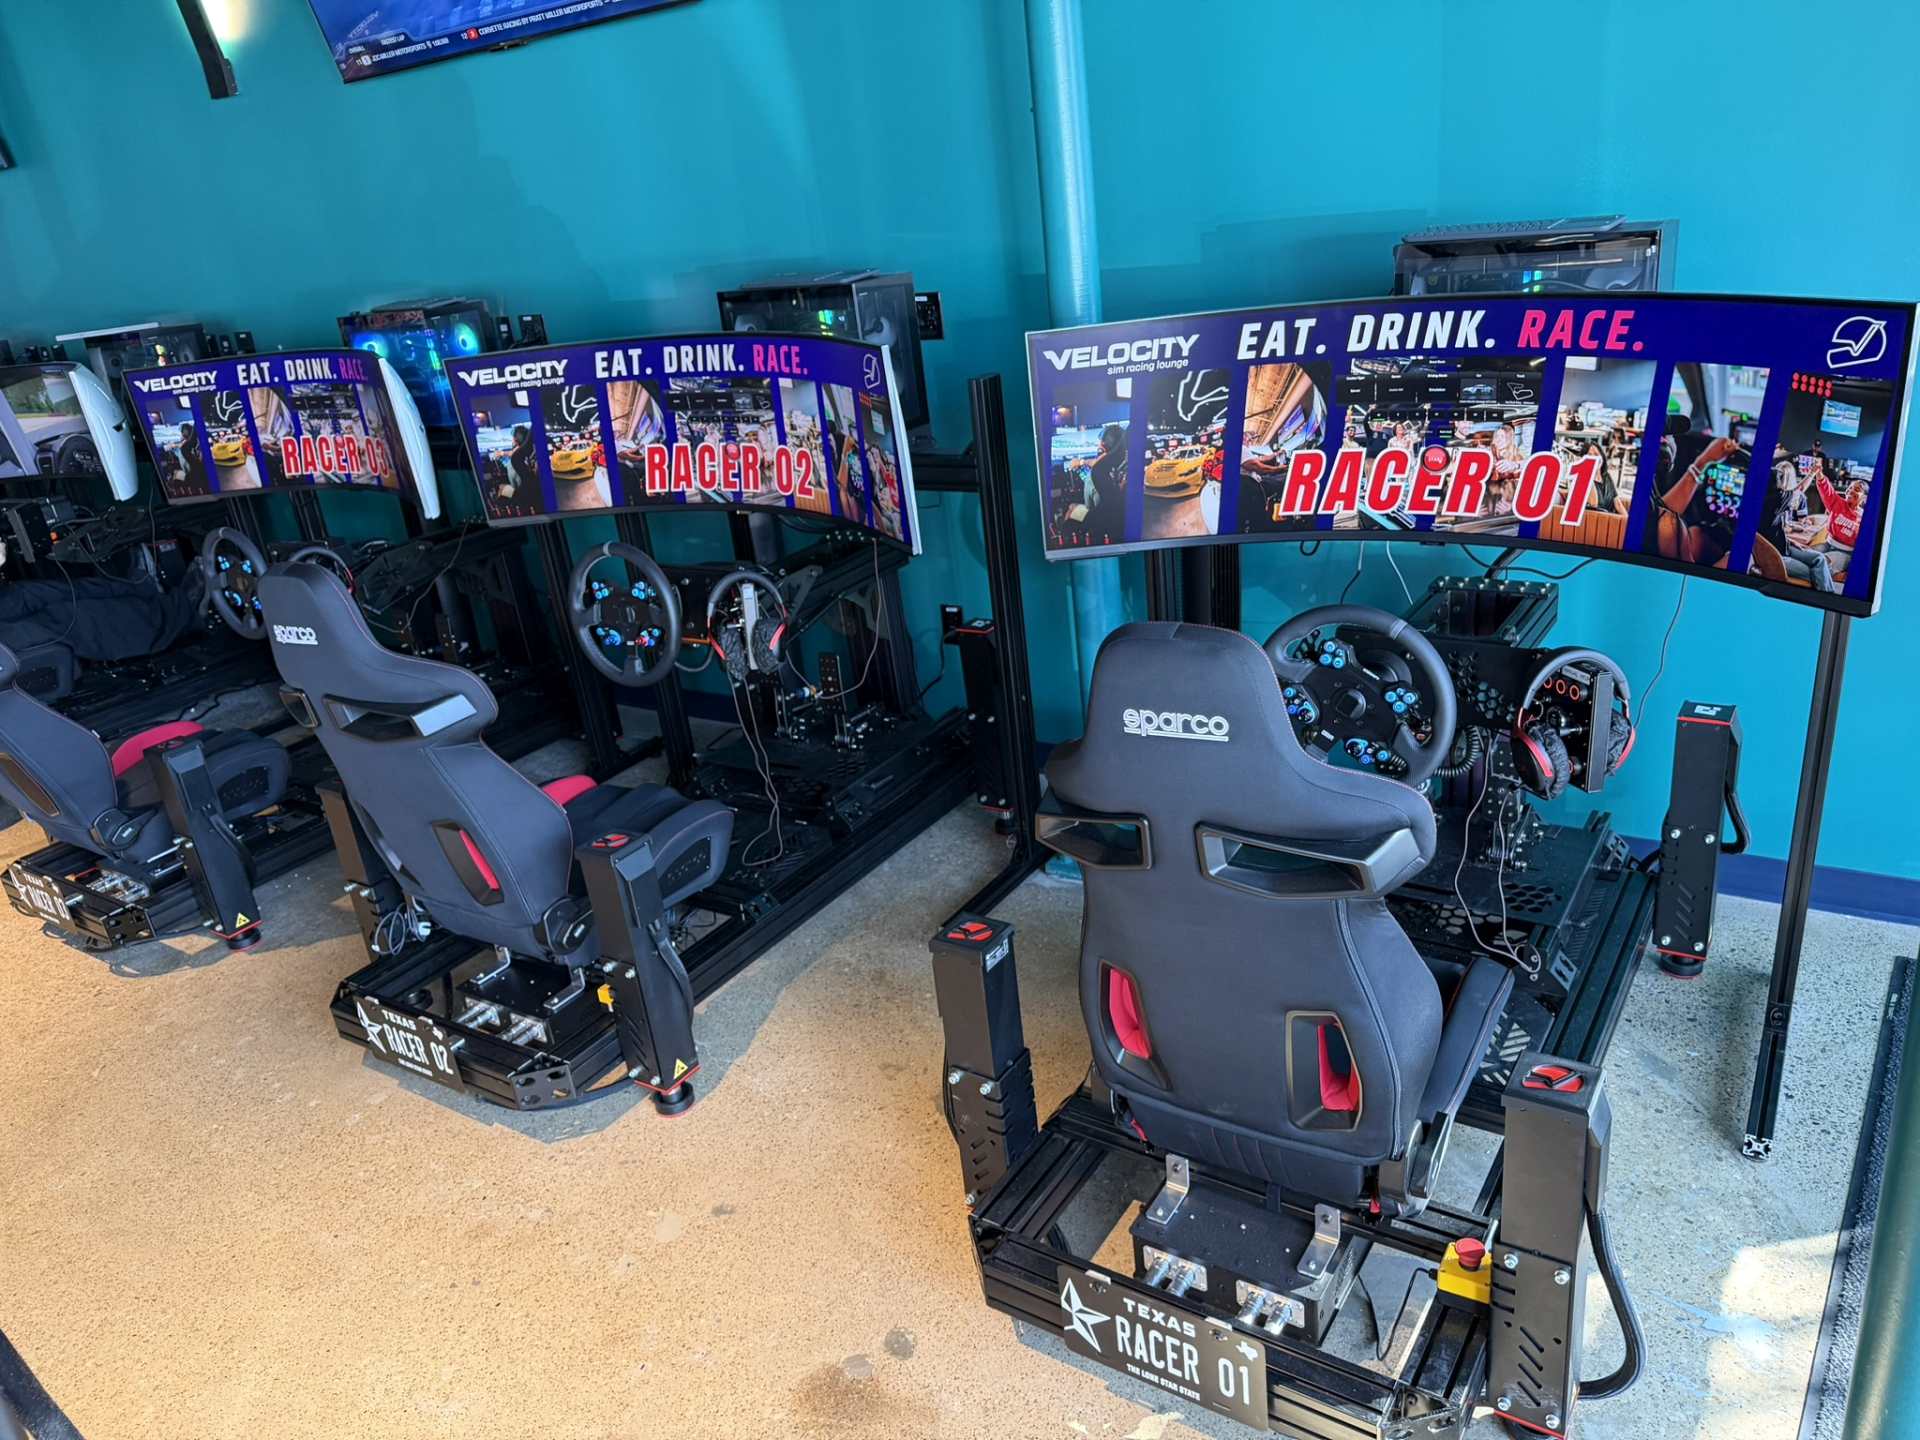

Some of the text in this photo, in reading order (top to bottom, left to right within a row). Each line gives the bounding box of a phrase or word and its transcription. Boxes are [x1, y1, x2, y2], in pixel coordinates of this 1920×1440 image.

[1042, 334, 1200, 371] VELOCITY
[1236, 309, 1644, 360] EAT. DRINK. RACE.
[237, 361, 279, 386] EAT.
[284, 358, 337, 382] DRINK.
[457, 359, 569, 387] VELOCITY
[595, 343, 808, 379] EAT. DRINK. RACE.
[1107, 359, 1189, 376] sim racing lounge
[133, 370, 217, 393] VELOCITY
[280, 434, 390, 478] RACER 03
[645, 442, 815, 499] RACER 02
[1278, 446, 1601, 527] RACER 01
[1123, 708, 1229, 738] sparco
[381, 1009, 417, 1031] TEXAS
[382, 1023, 430, 1065] RACER
[430, 1041, 454, 1075] 02
[1123, 1297, 1197, 1338] TEXAS
[1115, 1314, 1251, 1405] RACER 01
[1126, 1363, 1201, 1401] THE LONE STAR STATE
